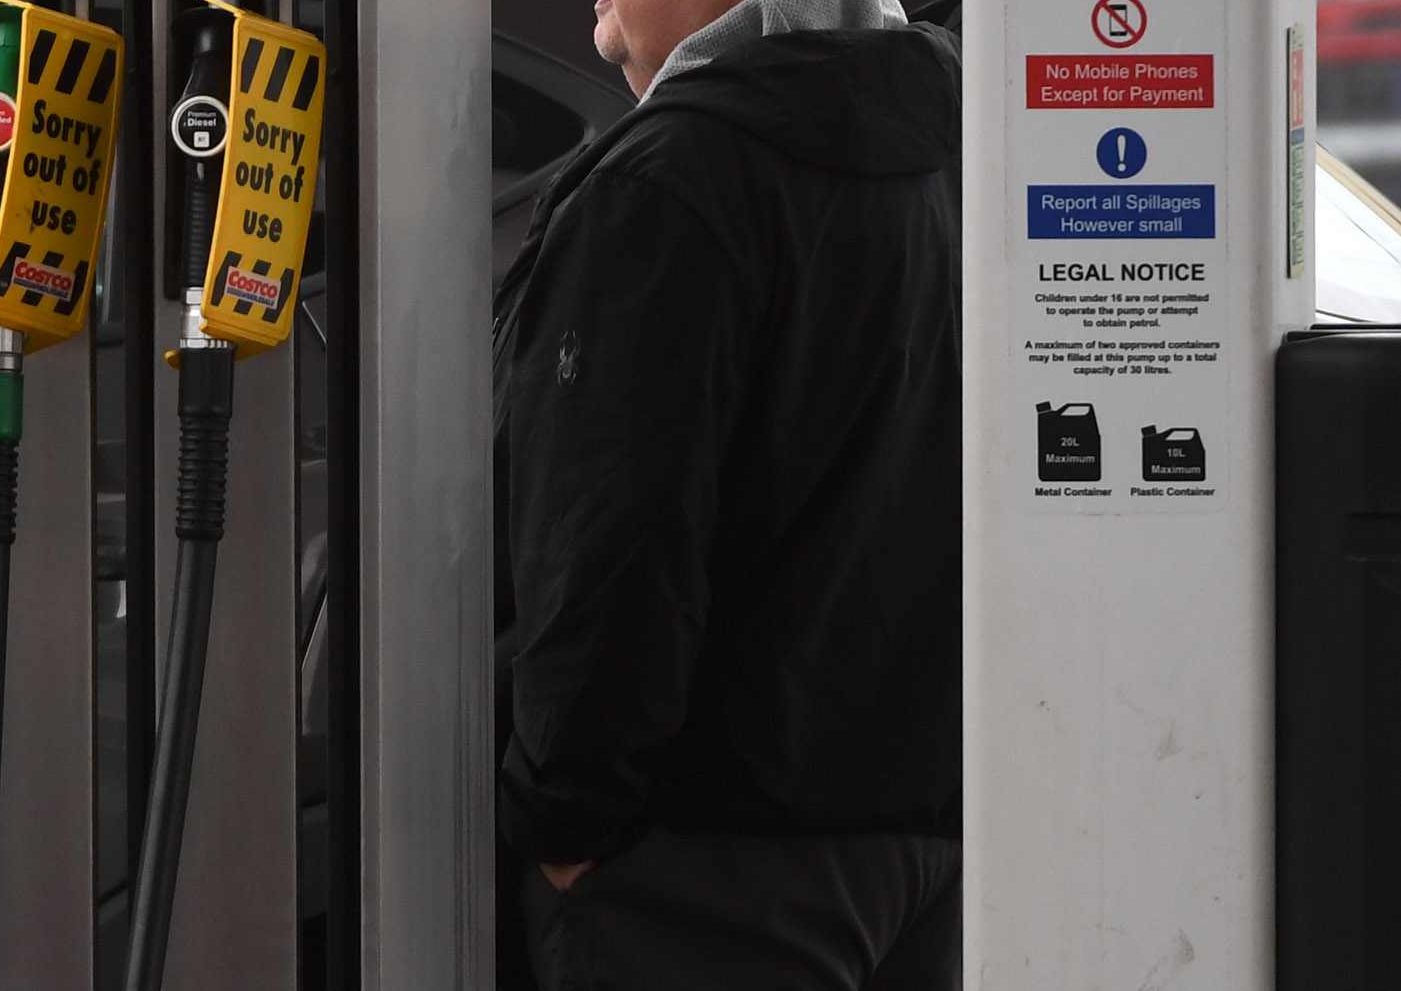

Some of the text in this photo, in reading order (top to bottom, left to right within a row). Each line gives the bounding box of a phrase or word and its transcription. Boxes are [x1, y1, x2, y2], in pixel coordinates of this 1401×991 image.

[1046, 63, 1198, 79] No Mobile Phones
[1041, 86, 1204, 105] Except for Payment
[32, 99, 102, 159] Sorry
[188, 118, 216, 126] Diesel
[243, 108, 306, 166] Sorry
[23, 152, 102, 195] out of
[235, 161, 305, 203] out of
[1042, 194, 1202, 213] Report all Spillages
[31, 200, 77, 235] use
[1061, 217, 1183, 232] However small
[243, 209, 283, 243] use
[15, 262, 72, 292] COSTCO
[1039, 264, 1205, 281] LEGAL NOTICE
[228, 270, 278, 299] COSTCO
[1035, 294, 1077, 303] Children
[1079, 294, 1108, 303] under
[1111, 294, 1123, 302] 16
[1143, 295, 1159, 303] not
[1162, 294, 1209, 304] permitted
[1046, 307, 1056, 315] to
[1059, 307, 1096, 317] operate
[1098, 306, 1114, 315] the
[1117, 308, 1145, 317] pump
[1161, 307, 1198, 316] attempt
[1083, 319, 1161, 328] to obtain petrol.
[1061, 437, 1079, 446] 20L
[1046, 454, 1095, 463] Maximum
[1167, 449, 1185, 457] 10L
[1151, 465, 1201, 474] Maximum
[1035, 488, 1112, 496] Metal Container
[1131, 488, 1215, 496] Plastic Container
